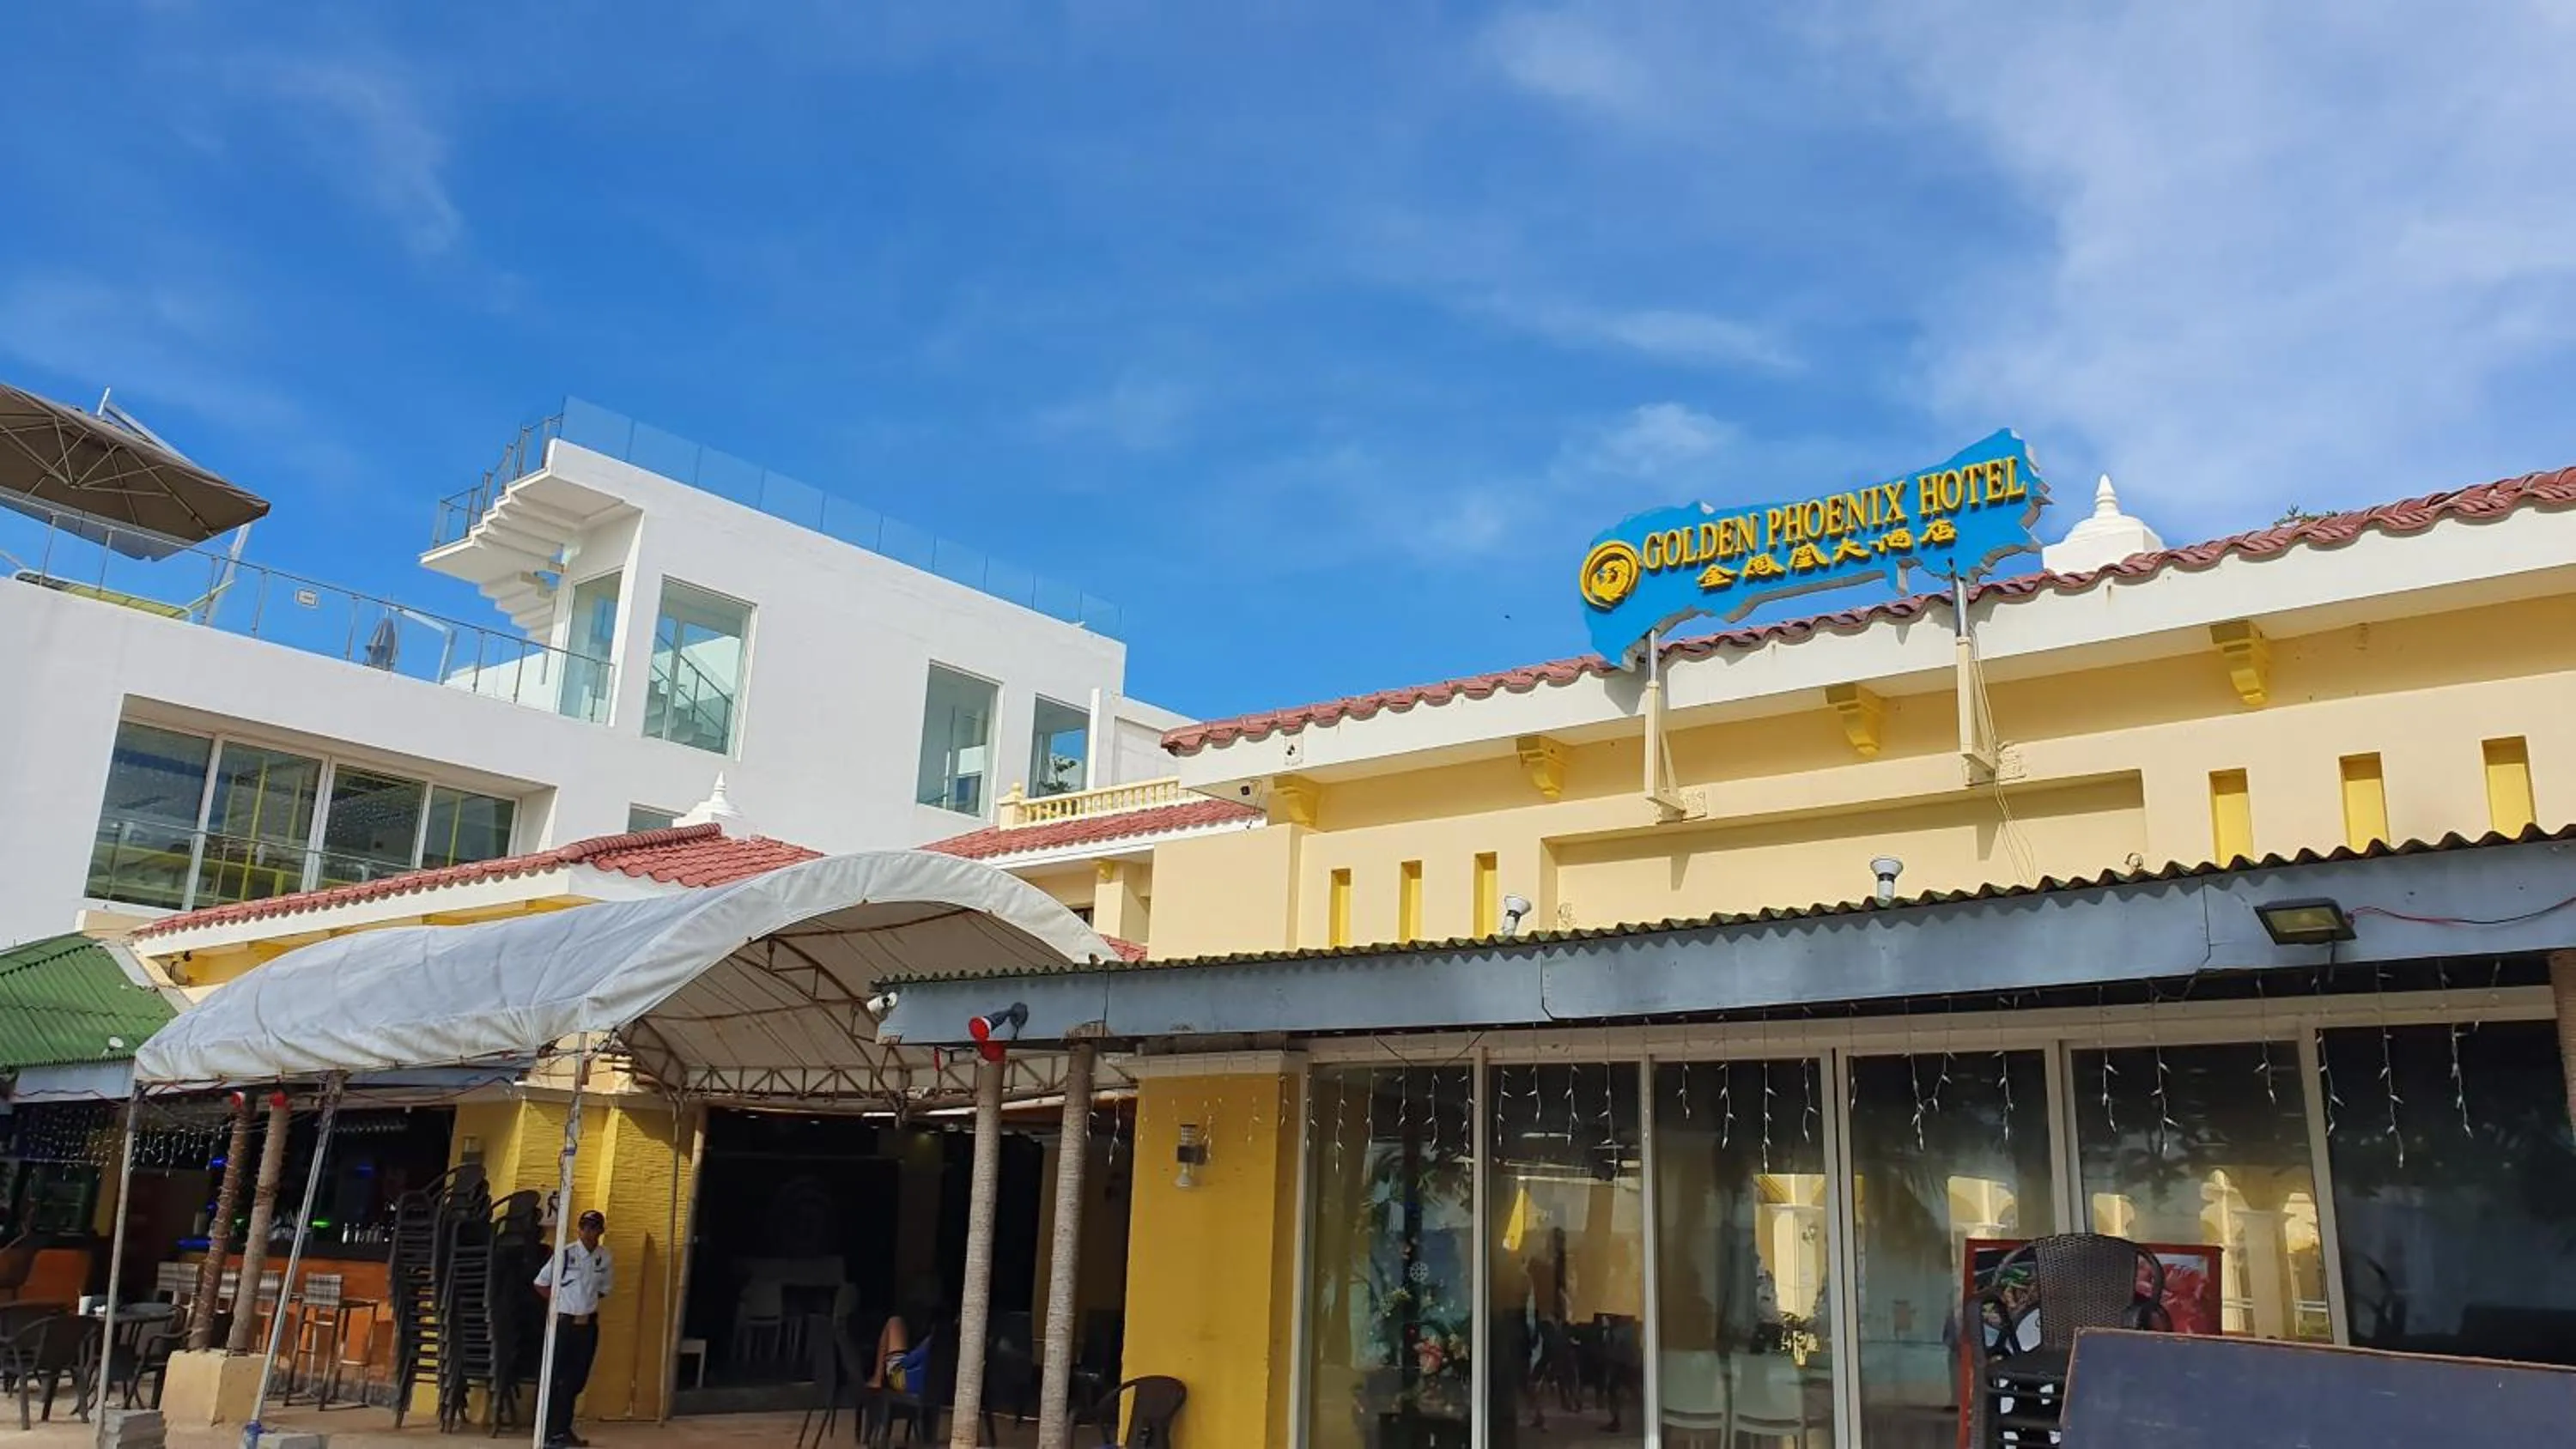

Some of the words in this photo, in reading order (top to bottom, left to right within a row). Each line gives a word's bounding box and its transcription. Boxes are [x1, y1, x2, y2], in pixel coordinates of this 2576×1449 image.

[1643, 512, 1759, 569] GOLDEN
[1766, 481, 1909, 546] PHOENIX
[1917, 456, 2027, 515] HOTEL
